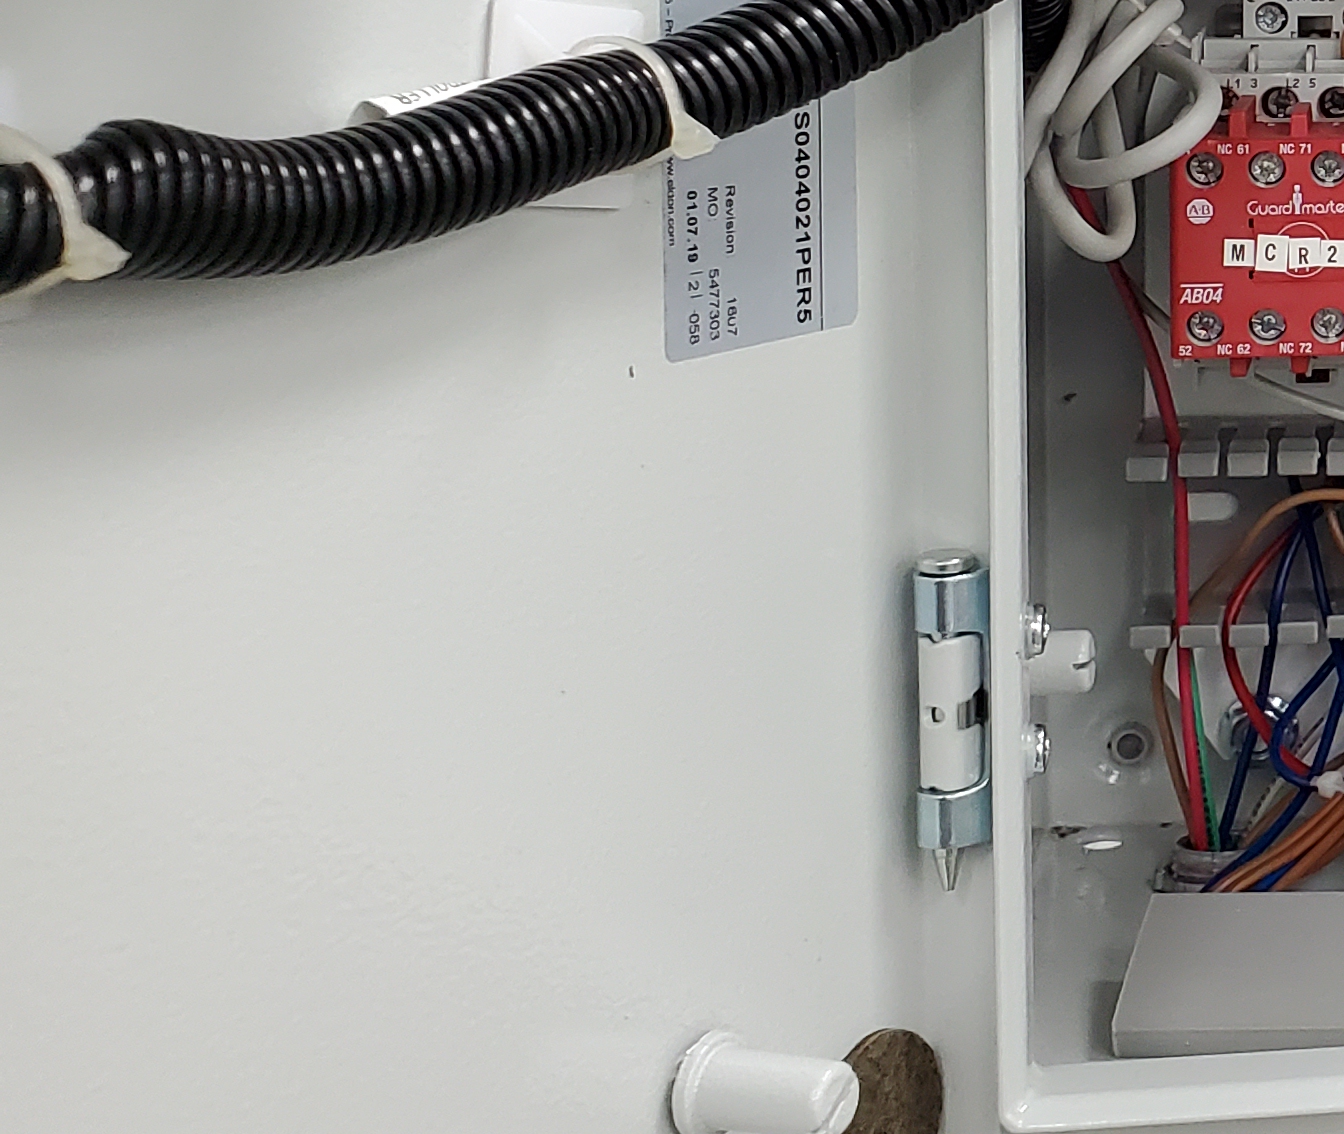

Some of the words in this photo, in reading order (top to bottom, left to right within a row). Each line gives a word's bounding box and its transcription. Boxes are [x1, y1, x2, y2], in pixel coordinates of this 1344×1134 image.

[1250, 78, 1258, 88] 3
[1308, 78, 1317, 88] 5
[1217, 143, 1233, 154] NC
[1236, 143, 1250, 155] 61
[1279, 143, 1295, 154] NC
[1299, 143, 1312, 154] 71
[708, 267, 721, 341] 5477303
[1178, 345, 1192, 356] 52
[1217, 343, 1233, 355] NC
[1236, 343, 1251, 355] 62
[1279, 342, 1295, 355] NC
[1299, 343, 1312, 355] 72
